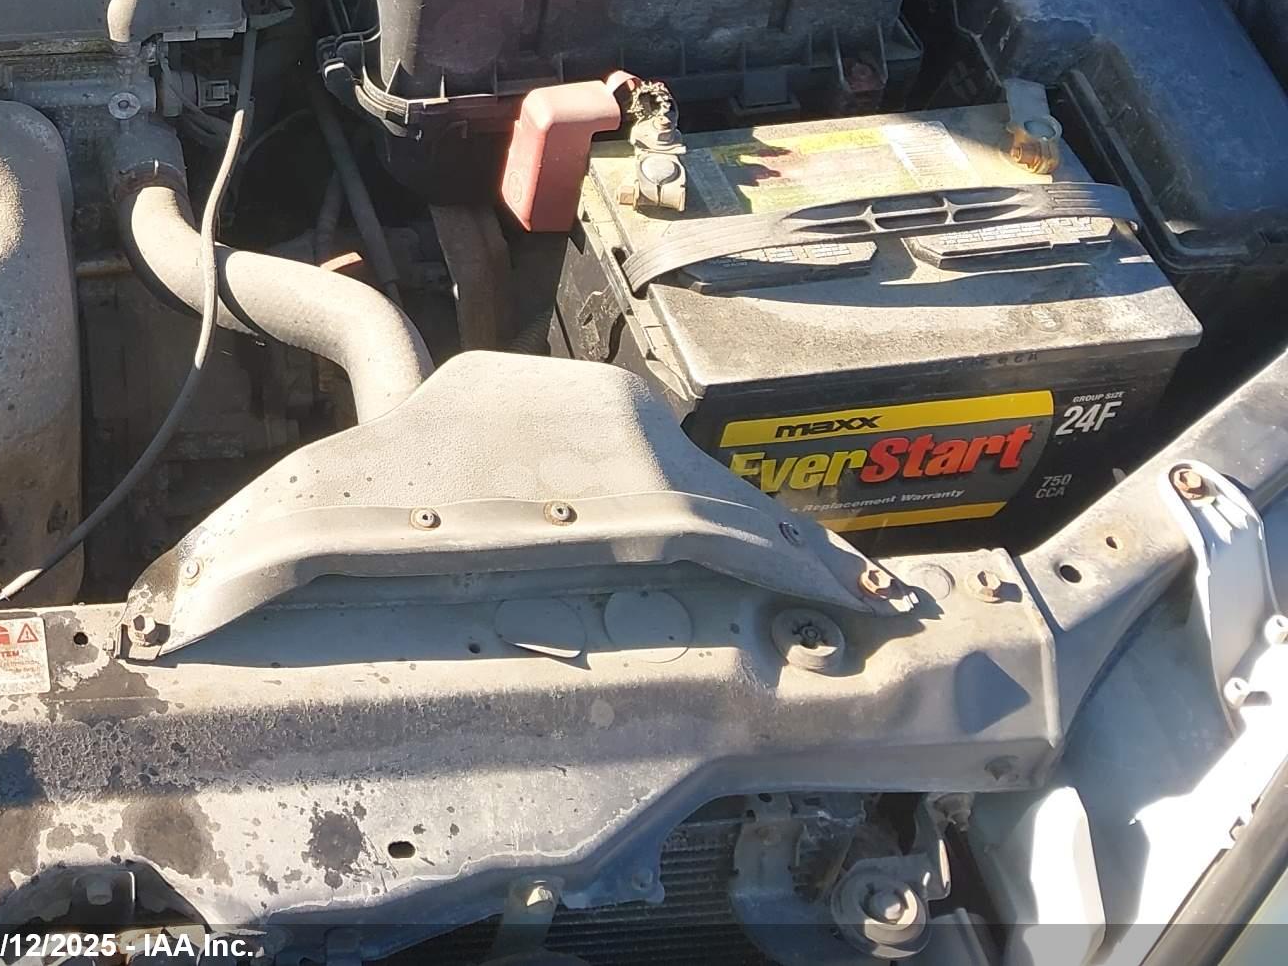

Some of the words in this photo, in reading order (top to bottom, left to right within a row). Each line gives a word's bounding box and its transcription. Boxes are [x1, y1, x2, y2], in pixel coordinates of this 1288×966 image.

[1072, 393, 1104, 403] GROUP
[775, 415, 882, 439] maxx
[1055, 400, 1122, 436] 24F
[730, 423, 1034, 493] EverStart
[1035, 486, 1065, 499] CCA
[1041, 473, 1072, 488] 750
[802, 495, 896, 513] Replacement
[901, 489, 965, 503] Warranty
